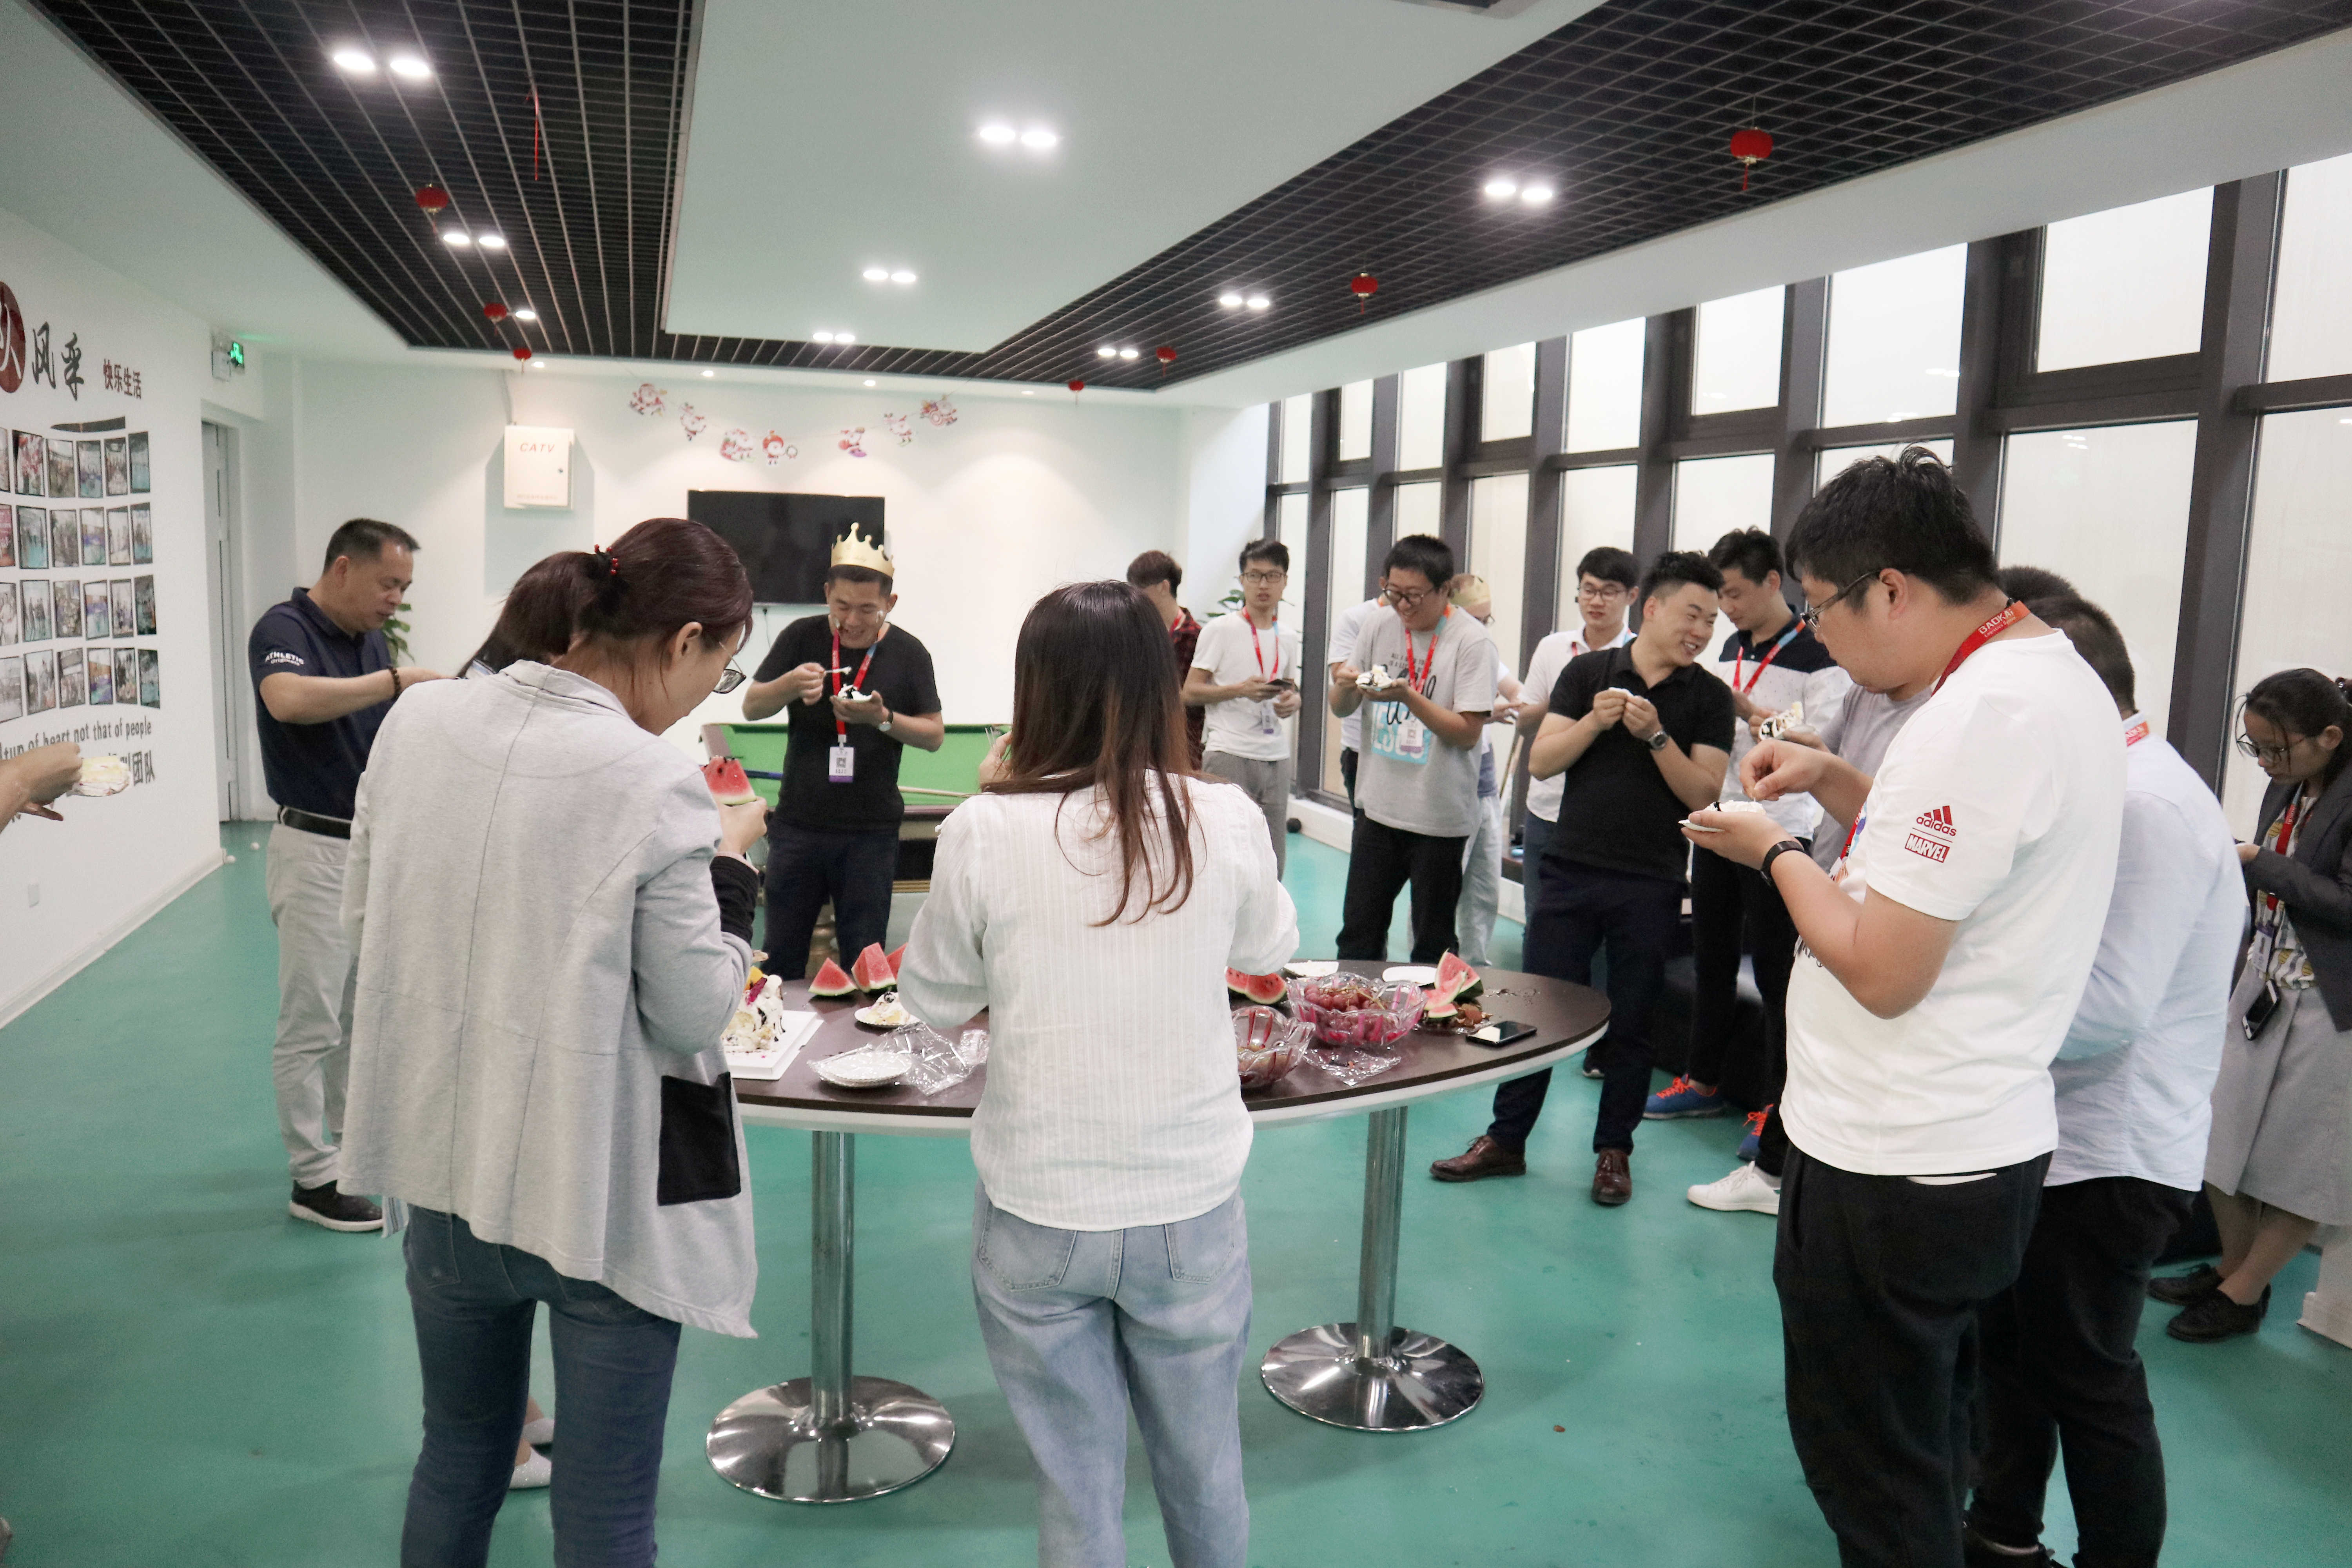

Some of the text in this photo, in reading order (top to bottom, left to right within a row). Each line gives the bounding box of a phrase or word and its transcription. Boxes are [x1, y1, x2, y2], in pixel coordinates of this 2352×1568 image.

[103, 358, 142, 399] 快乐生活
[520, 443, 555, 452] CATV
[43, 731, 69, 746] heart
[74, 723, 89, 743] not
[93, 720, 111, 740] that
[115, 717, 122, 737] of
[125, 715, 151, 740] people
[1916, 817, 1957, 837] adidas
[1906, 834, 1947, 862] MARVEL
